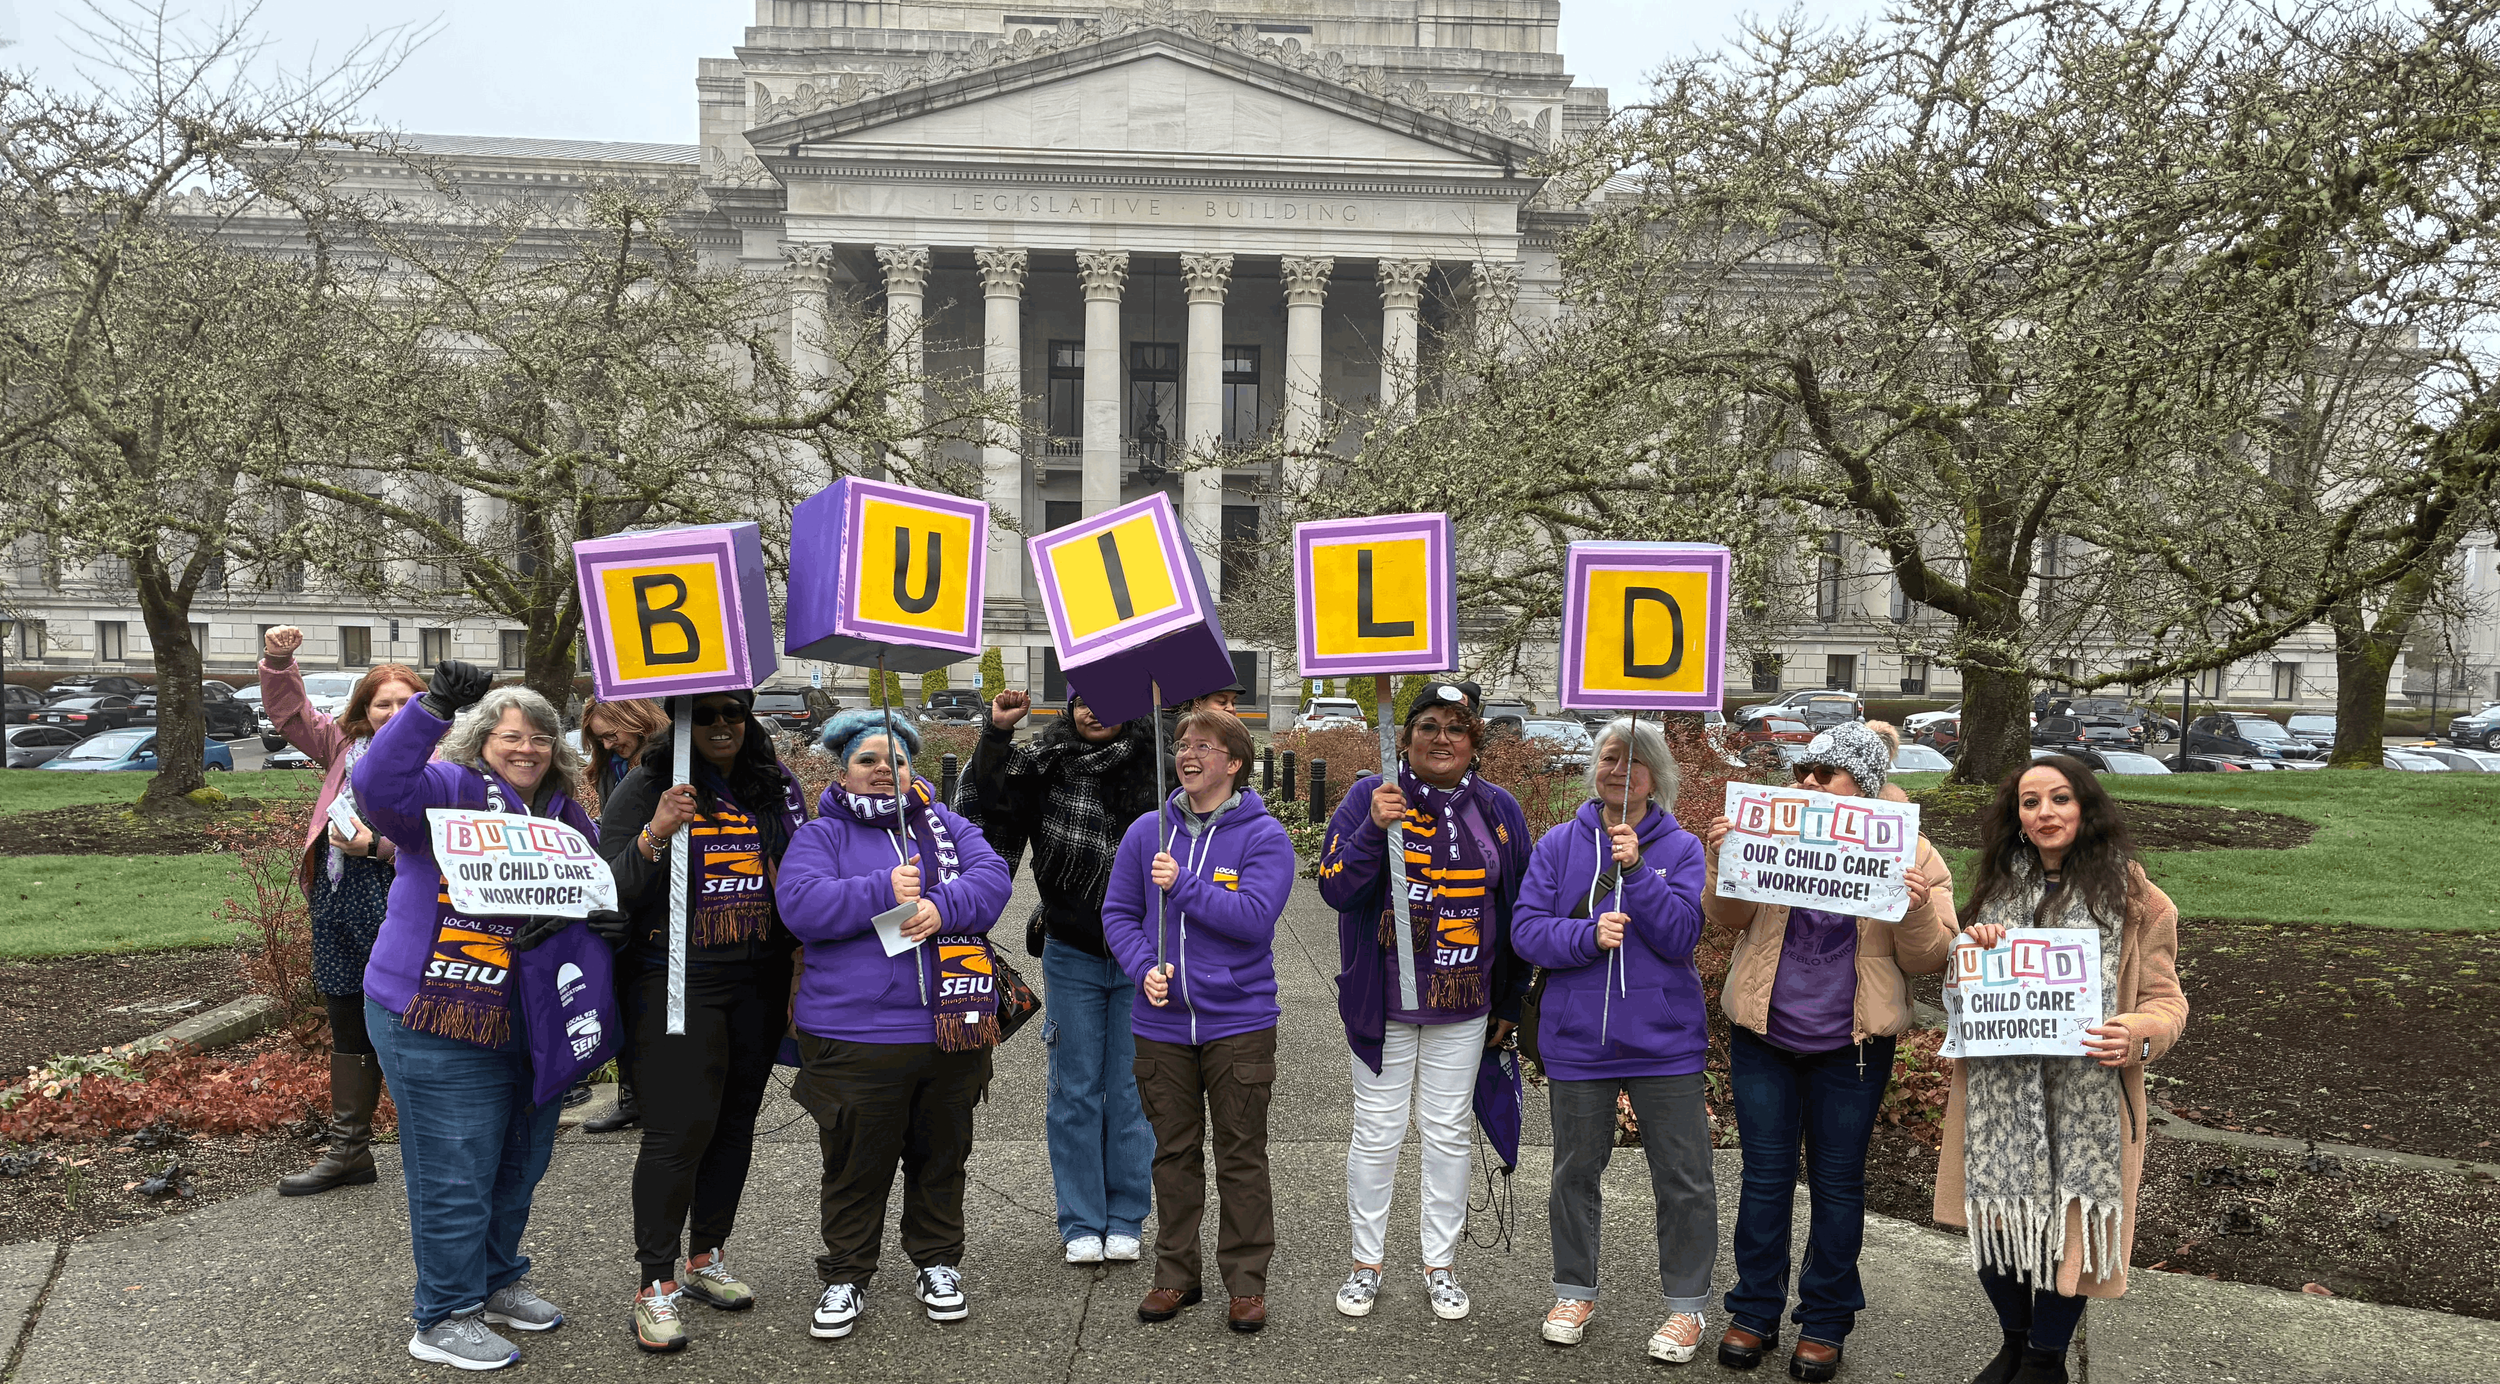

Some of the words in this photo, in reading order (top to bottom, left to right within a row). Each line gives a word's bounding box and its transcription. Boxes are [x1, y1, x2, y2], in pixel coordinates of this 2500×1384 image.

[952, 193, 1161, 216] LEGISLATIVE
[1205, 200, 1358, 222] BUILDING
[892, 526, 941, 614] U
[1096, 530, 1135, 621] I
[1357, 549, 1415, 638] L
[631, 572, 701, 666] B
[1624, 586, 1685, 679] D
[1748, 804, 1892, 846] BUILD
[458, 824, 582, 855] BUILD
[703, 843, 742, 852] LOCAL
[744, 842, 761, 851] 925
[459, 862, 493, 882] OUR
[499, 861, 549, 881] CHILD
[554, 863, 595, 881] CARE
[1214, 865, 1238, 876] LOCAL
[1743, 843, 1779, 866] OUR
[1784, 847, 1837, 872] CHILD
[1842, 855, 1891, 879] CARE
[478, 886, 583, 906] WORKFORCE!
[701, 876, 764, 894] SEIU
[1756, 869, 1871, 902] WORKFORCE!
[1460, 907, 1480, 917] 925
[442, 916, 483, 931] LOCAL
[488, 923, 514, 935] 925
[937, 935, 970, 945] LOCAL
[1433, 945, 1480, 967] SEIU
[1781, 945, 1822, 967] UEBLO
[424, 960, 509, 985] SEIU
[425, 979, 462, 989] Stronger
[465, 982, 504, 997] Together
[939, 976, 993, 998] SEIU
[1971, 991, 2021, 1014] CHILD
[2025, 990, 2076, 1012] CARE
[565, 1014, 585, 1028] LOCAL
[583, 1008, 598, 1019] 925
[572, 1031, 602, 1057] SEIU
